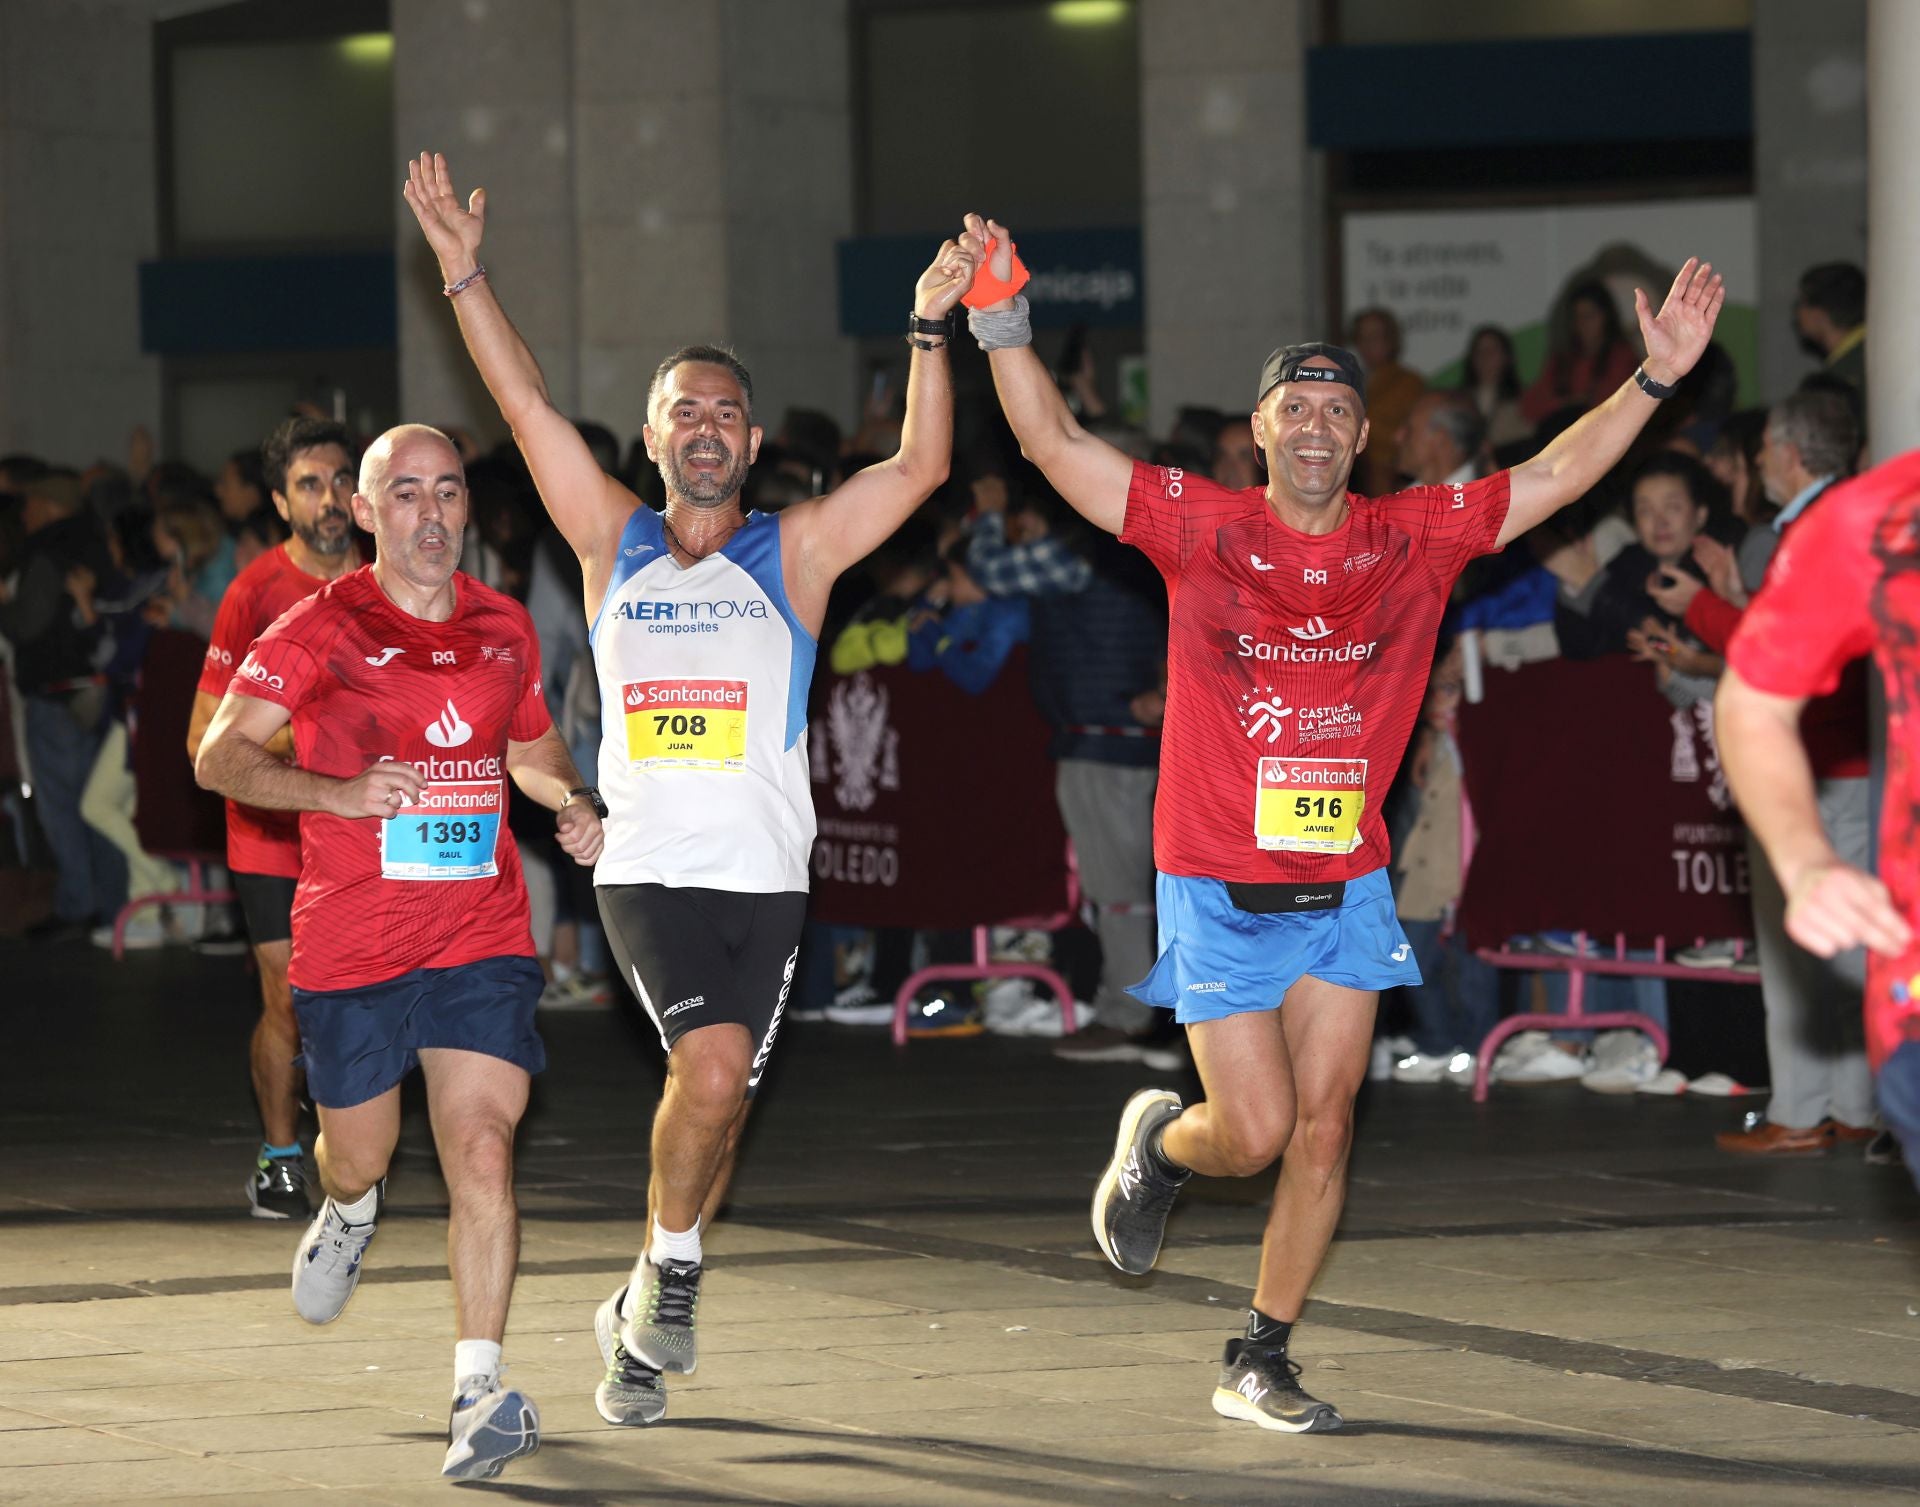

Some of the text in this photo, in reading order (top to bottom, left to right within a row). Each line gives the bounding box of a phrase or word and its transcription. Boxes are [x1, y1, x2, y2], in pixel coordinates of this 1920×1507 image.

[648, 621, 719, 636] composites
[1237, 634, 1377, 663] Santander
[647, 685, 744, 704] Santander
[653, 714, 707, 736] 708
[1298, 711, 1363, 731] LA MANCHA
[1311, 731, 1343, 742] DEPORTE
[1342, 723, 1362, 738] 2024
[667, 742, 693, 750] JUAN
[379, 754, 502, 780] ntander
[1290, 766, 1361, 785] Santande
[418, 791, 500, 808] Santander
[1294, 796, 1342, 819] 516
[416, 821, 481, 844] 1393
[1303, 825, 1335, 833] JAVIER
[439, 851, 462, 859] RAUL
[813, 839, 899, 887] OLEDO
[1671, 850, 1750, 894] TOLE
